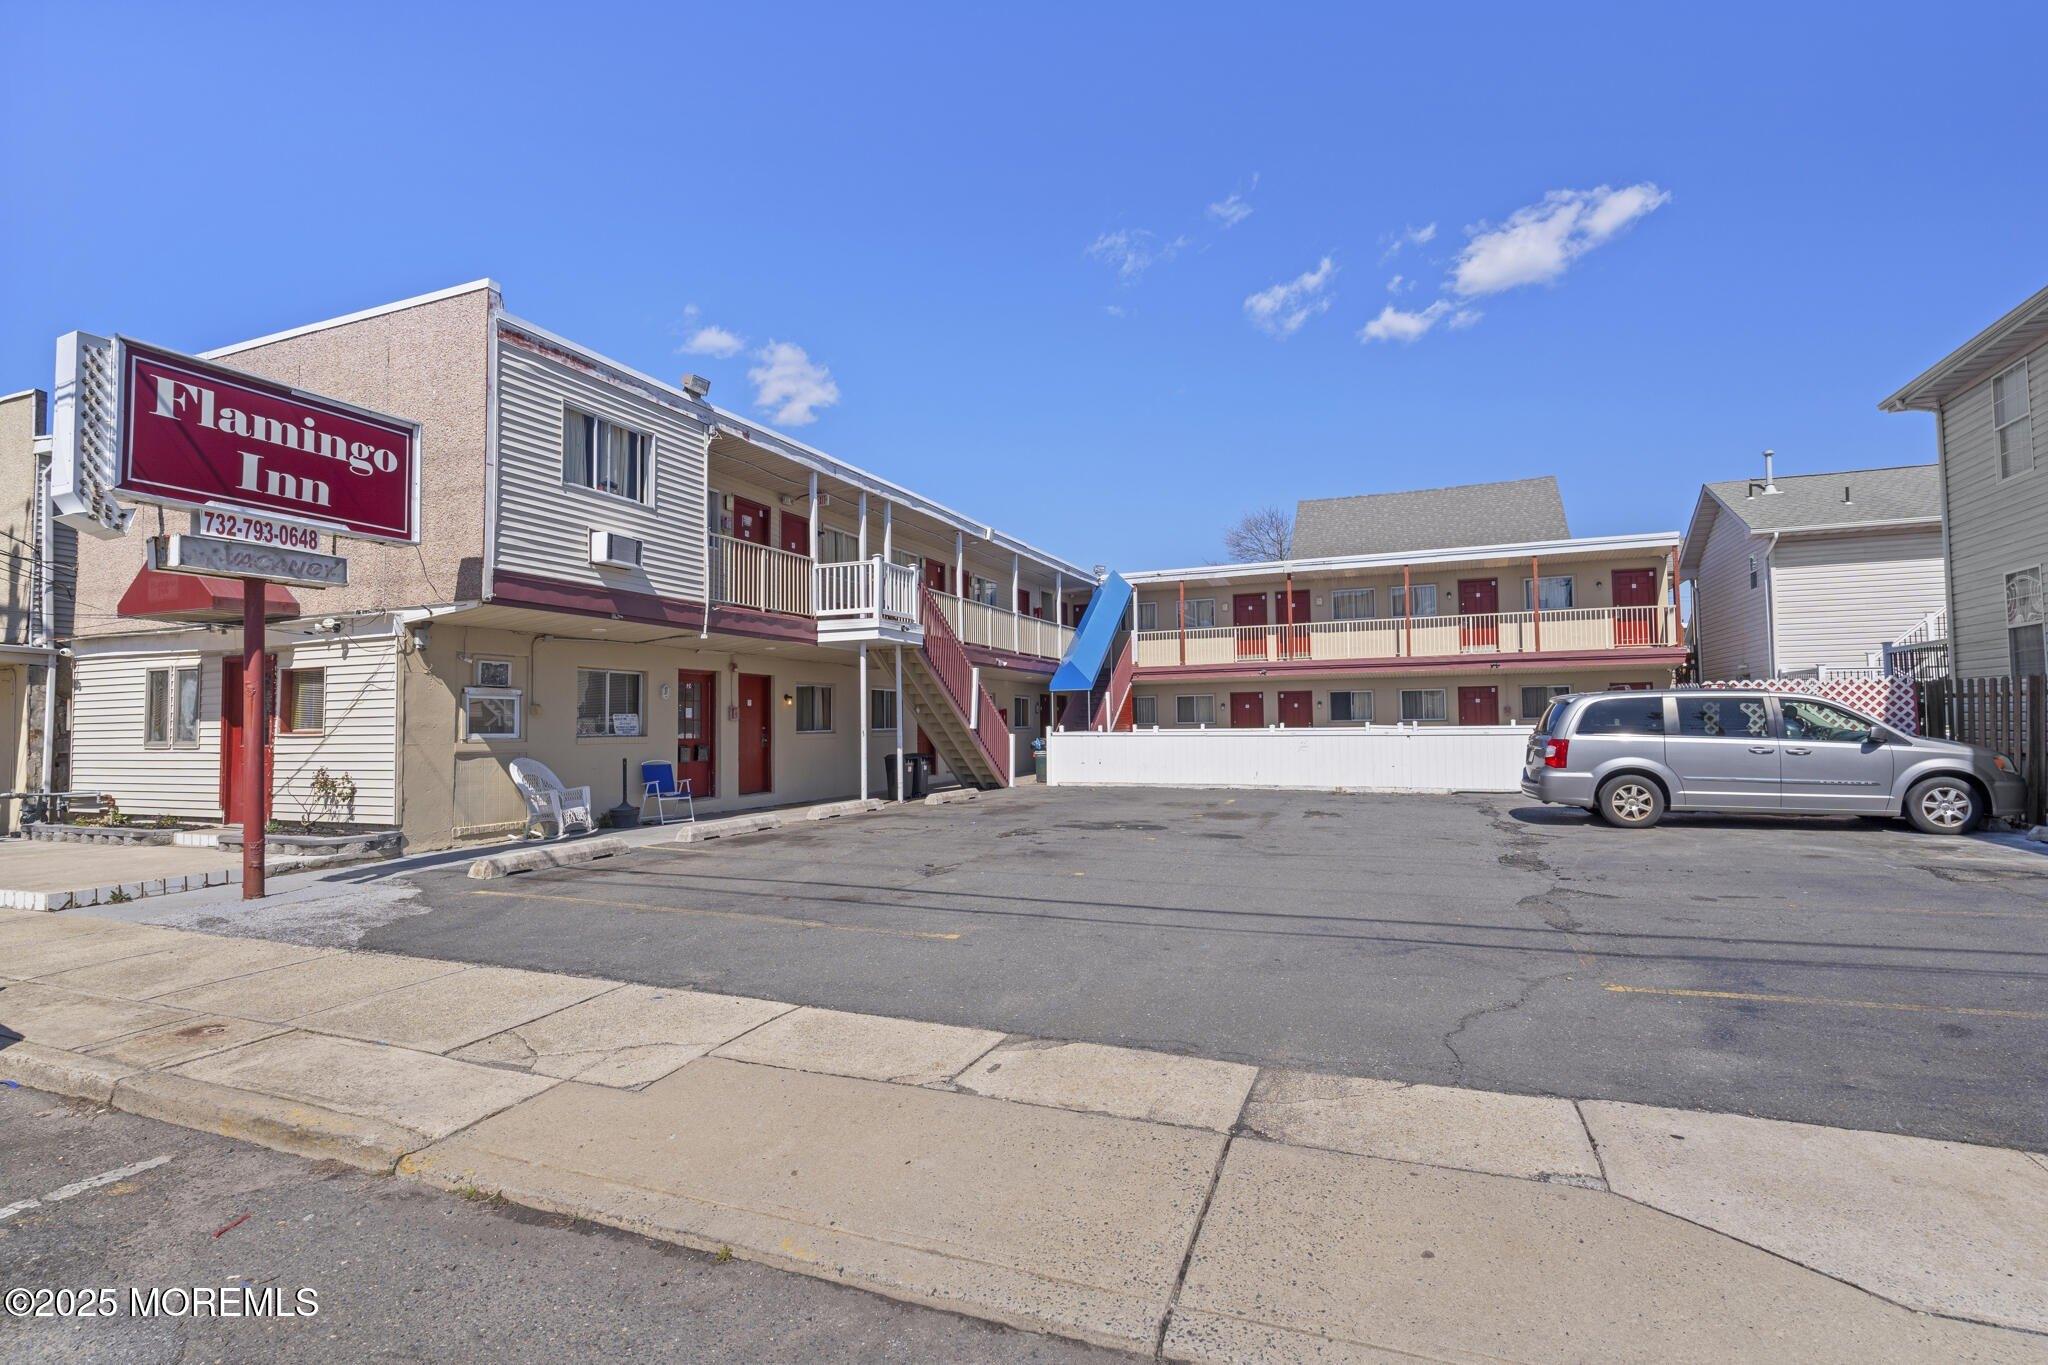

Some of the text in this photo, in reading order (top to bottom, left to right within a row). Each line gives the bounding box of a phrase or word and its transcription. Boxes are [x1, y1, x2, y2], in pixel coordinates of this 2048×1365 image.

[149, 374, 398, 476] Flamingo
[235, 451, 331, 507] Inn
[204, 511, 318, 550] 732-793-0648
